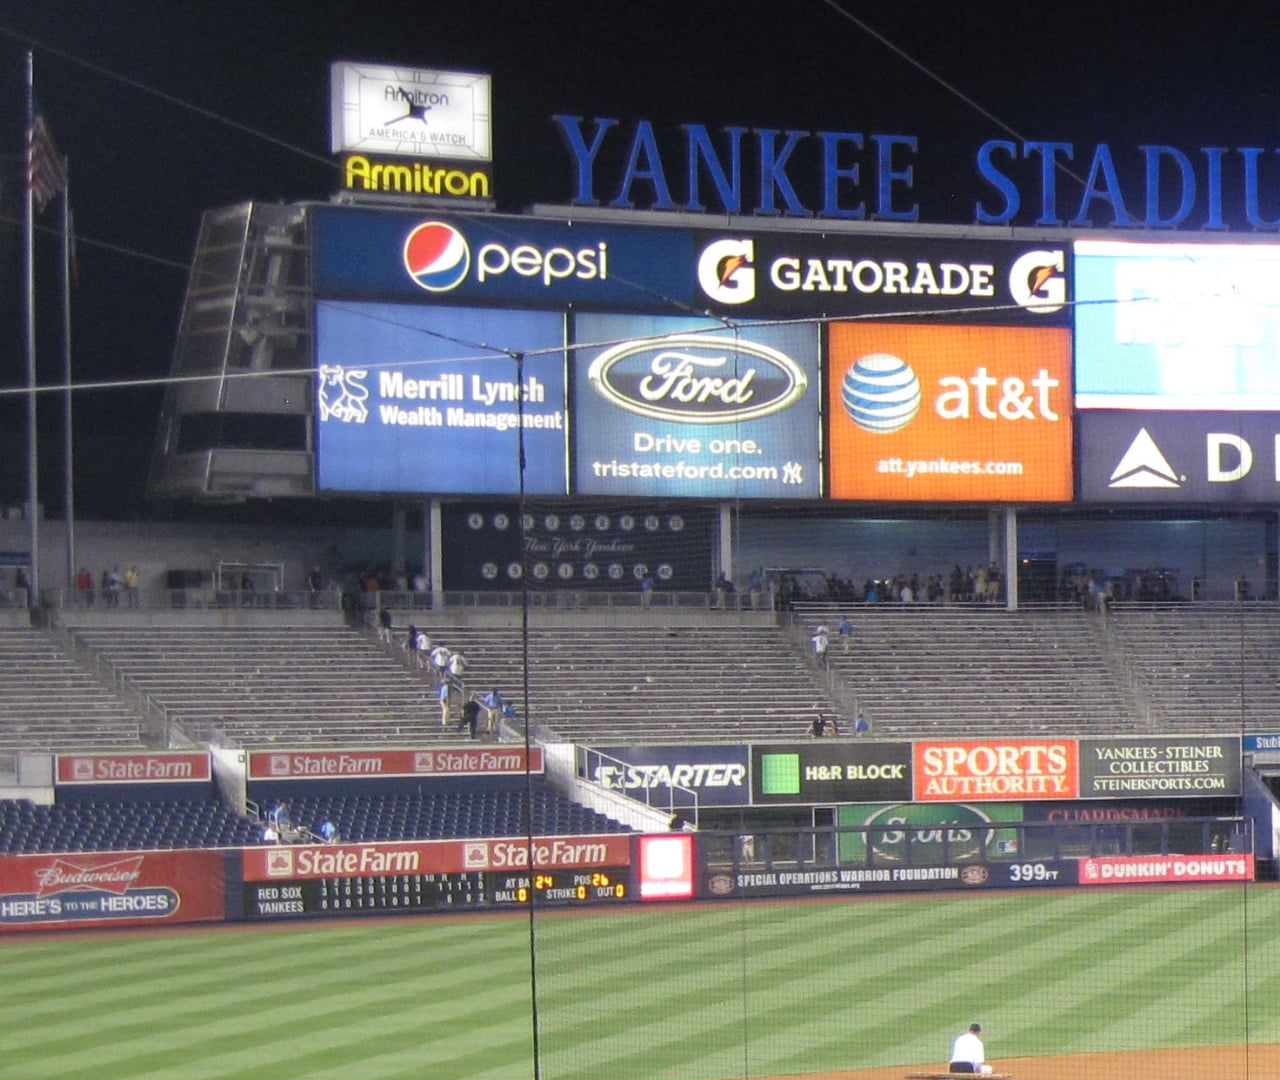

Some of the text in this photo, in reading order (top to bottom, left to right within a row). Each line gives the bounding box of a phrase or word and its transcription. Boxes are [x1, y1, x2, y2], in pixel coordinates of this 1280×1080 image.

[384, 85, 449, 106] Armitron
[369, 127, 466, 144] AMERICA'S WATCH
[345, 155, 489, 197] Armitron
[552, 114, 919, 221] YANKEE
[477, 242, 608, 286] pepsi
[770, 258, 994, 297] GATORADE
[380, 371, 545, 404] Merrill Lynch
[639, 351, 754, 406] Ford
[934, 367, 1059, 421] at&t
[380, 404, 562, 431] Wealth Management
[633, 432, 763, 455] Drive one.
[593, 461, 777, 481] tristateford.com
[877, 456, 1023, 479] att.yankees.com
[923, 744, 1067, 776] SPORTS
[1109, 760, 1210, 774] COLLECTIBLES
[623, 763, 747, 788] STARTER
[805, 764, 904, 780] H&R BLOCK
[923, 775, 1067, 796] AUTHORITY
[1093, 777, 1225, 792] STEINERSPORTS.COM
[35, 865, 141, 887] Budweiser
[737, 867, 959, 888] SPECIAL OPERATIONS WARRIOR FOUNDATION
[1101, 859, 1246, 880] DUNKIN' DONUTS
[506, 873, 610, 889] AT BA 24 POS 26
[258, 887, 302, 900] RED SOX
[495, 885, 624, 902] BALL 0 STRIKE 0 OUT 0
[1, 895, 169, 918] HERE'S TO THE HEROES
[258, 901, 304, 914] YANKEES
